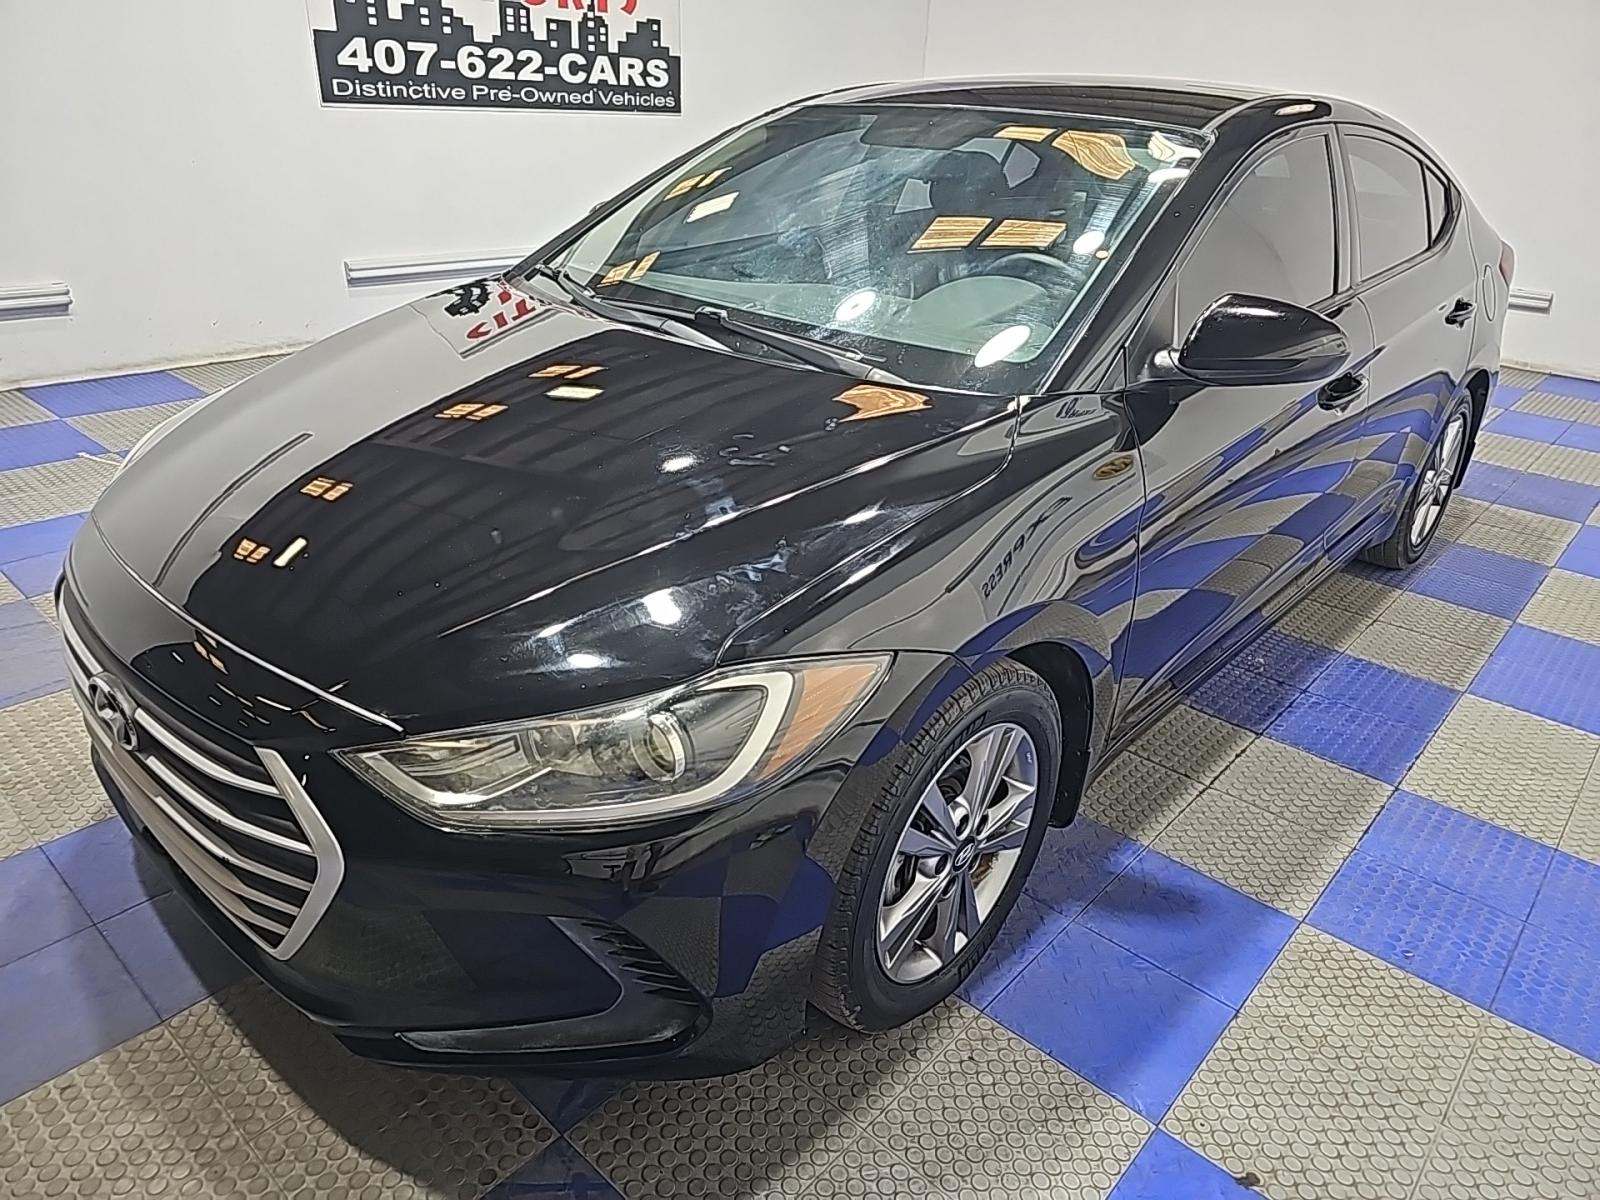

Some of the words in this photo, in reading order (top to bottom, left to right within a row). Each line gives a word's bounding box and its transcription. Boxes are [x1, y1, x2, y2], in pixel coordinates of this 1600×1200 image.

[337, 37, 669, 88] 407-622-CARS
[332, 78, 465, 100] Distinctive
[473, 86, 594, 105] Pre-Owned
[598, 88, 676, 107] Vehicles
